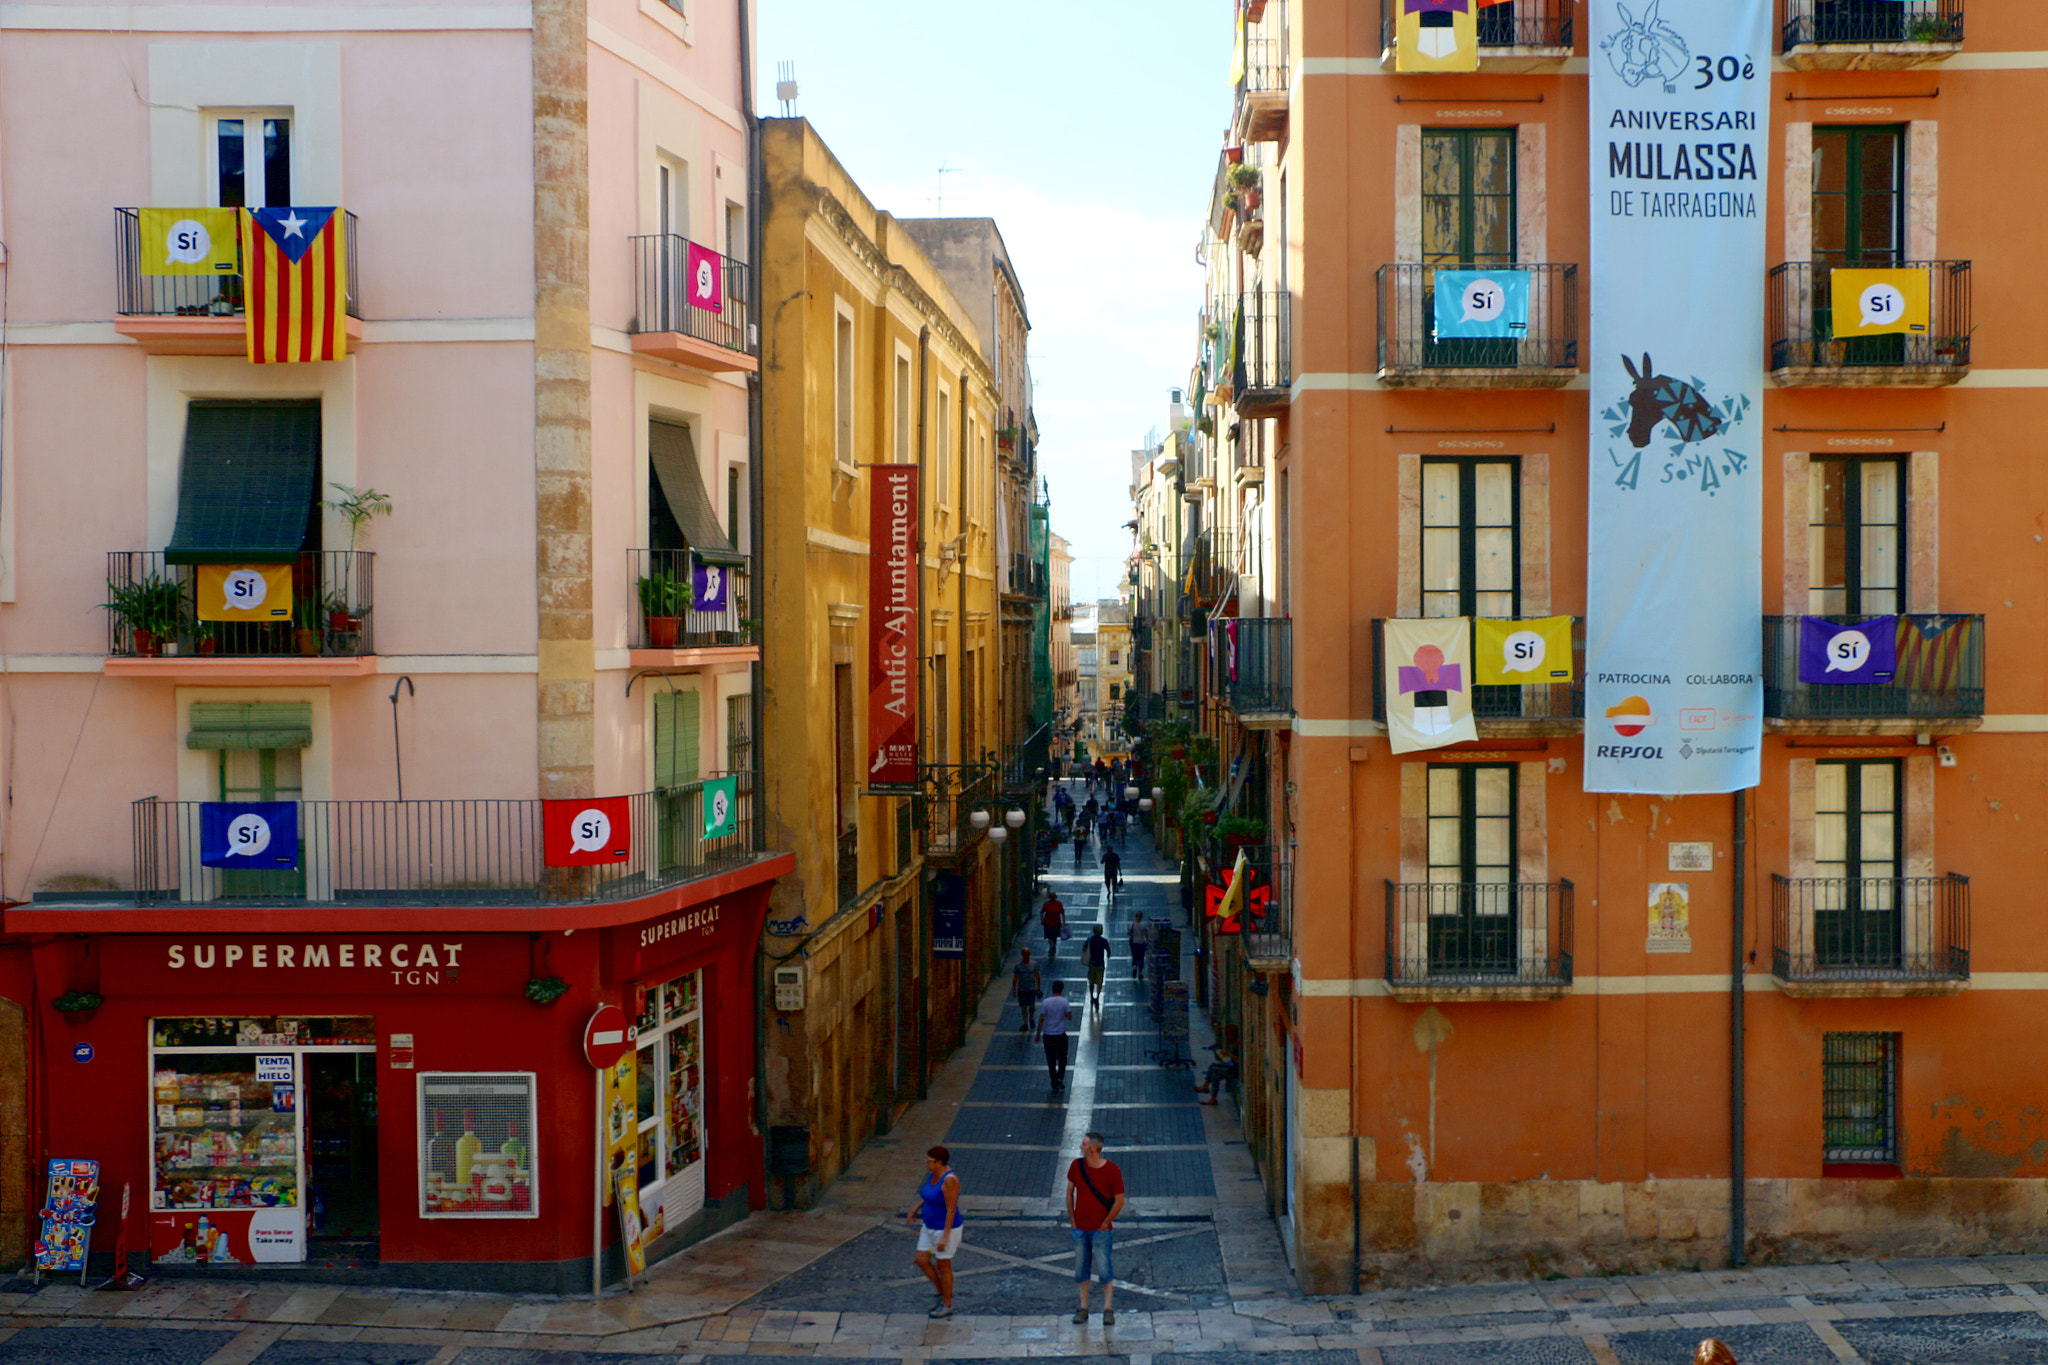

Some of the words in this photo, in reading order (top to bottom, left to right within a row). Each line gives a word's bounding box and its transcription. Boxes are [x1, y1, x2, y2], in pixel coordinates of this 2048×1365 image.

[1694, 53, 1755, 90] 30è
[1609, 109, 1756, 131] ANIVERSARI
[1609, 142, 1757, 180] MULASSA
[1610, 190, 1634, 217] DE
[1640, 191, 1757, 218] TARRAGONA
[177, 231, 198, 251] Sí
[1472, 290, 1494, 309] Sí
[1870, 294, 1892, 312] Sí
[1609, 447, 1642, 491] LA
[884, 473, 914, 636] Ajuntament
[234, 578, 255, 597] Sí
[1514, 640, 1535, 659] Sí
[1837, 641, 1859, 659] Sí
[884, 645, 907, 719] Antic
[1598, 673, 1671, 684] PATROCINA
[1597, 745, 1664, 759] REPSOL
[238, 825, 260, 844] Sí
[581, 820, 601, 839] Sí
[641, 905, 720, 947] SUPERMERCAT
[168, 943, 463, 969] SUPERMERCAT
[390, 970, 439, 985] TGN
[258, 1057, 290, 1066] VENTA
[258, 1072, 291, 1080] HIELO
